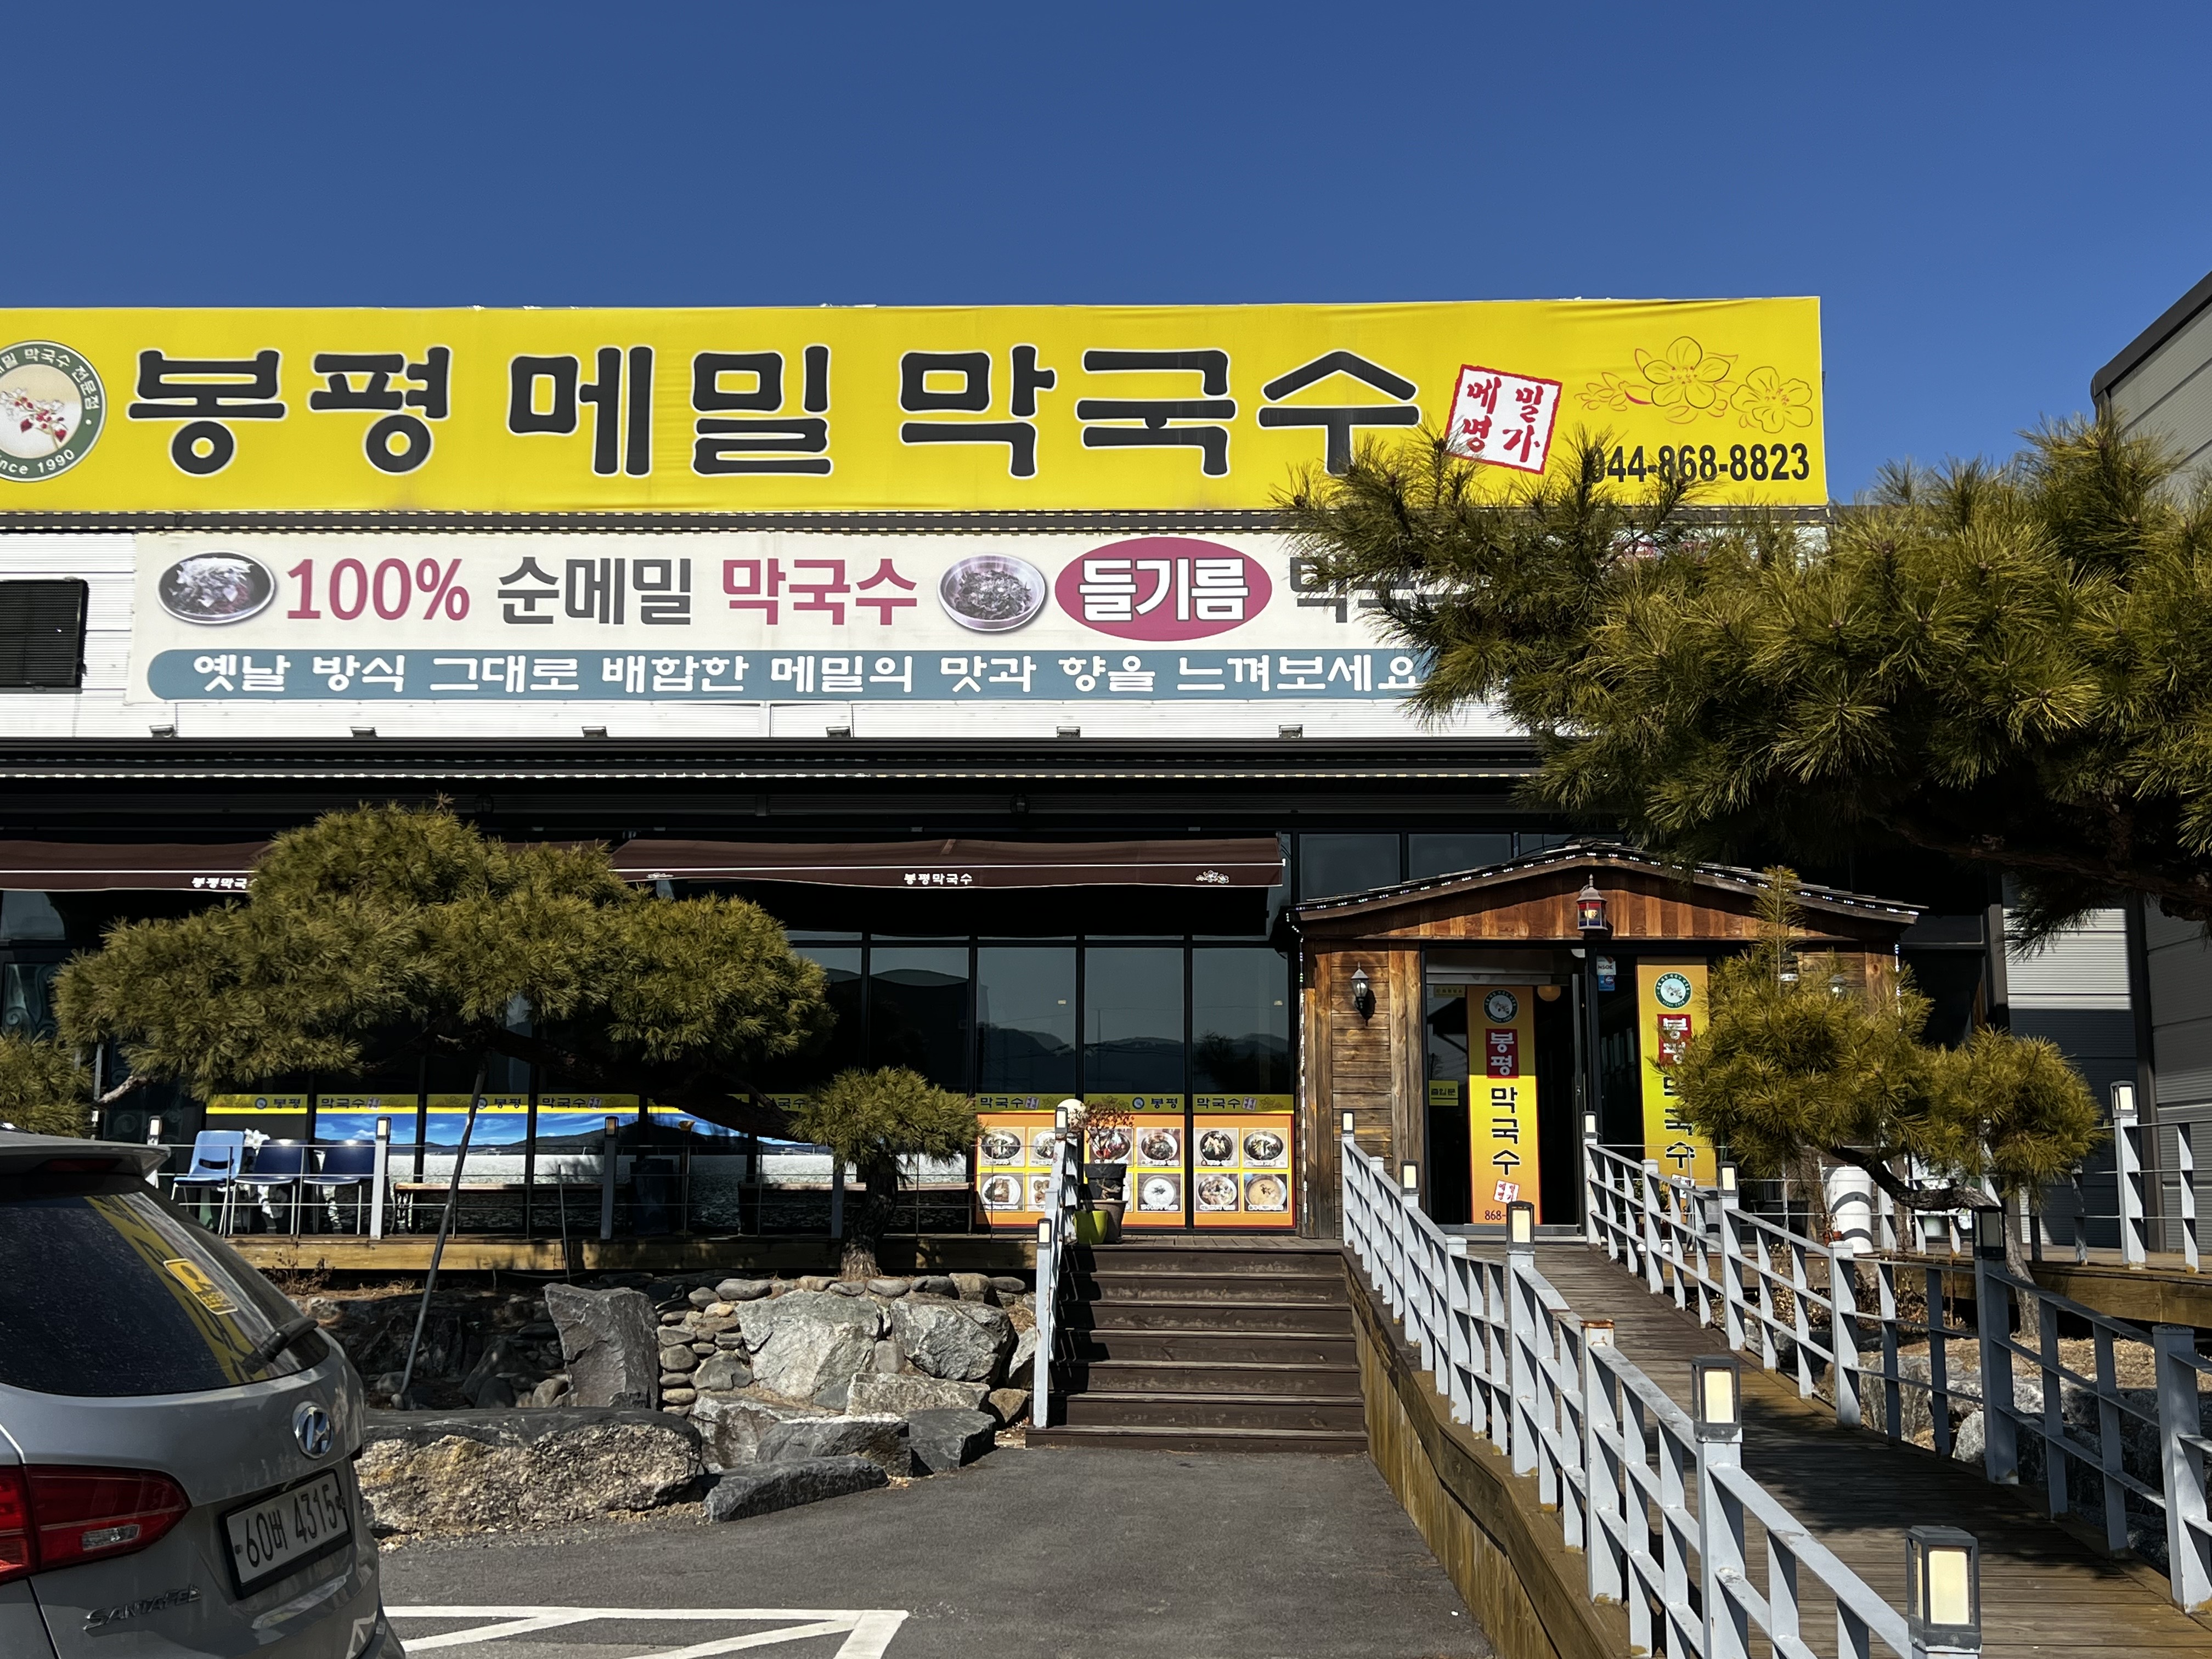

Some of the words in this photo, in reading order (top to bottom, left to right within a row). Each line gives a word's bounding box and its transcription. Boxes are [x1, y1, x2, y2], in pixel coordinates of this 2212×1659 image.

[0, 352, 19, 375] 밀
[24, 348, 71, 368] 막국수
[71, 365, 100, 410] 전문점
[128, 346, 450, 476] 봉평
[507, 346, 833, 476] 메밀
[899, 344, 1419, 477] 막국수
[1466, 376, 1544, 423] 메밀
[0, 454, 29, 474] nce
[37, 448, 75, 473] 1990
[1588, 443, 1810, 483] 044-868-8823
[287, 557, 470, 620] 100%
[497, 556, 692, 625] 순메밀
[722, 558, 918, 625] 막국수
[1079, 557, 1249, 622] 들기름
[194, 654, 291, 692] 옛날
[312, 654, 405, 692] 방식
[430, 654, 579, 692] 그대로
[602, 654, 749, 692] 배합한
[770, 654, 913, 692] 메밀의
[940, 654, 1037, 692] 맛과
[1058, 654, 1155, 692] 향을
[1177, 654, 1419, 692] 느껴보세요
[904, 873, 973, 885] 봉평막국수
[1489, 1031, 1515, 1076] 봉평
[321, 1098, 365, 1109] 막국수
[541, 1097, 586, 1109] 막국수
[980, 1097, 1024, 1109] 막국수
[1150, 1097, 1178, 1109] 봉평
[1197, 1097, 1241, 1109] 막국수
[1491, 1086, 1520, 1176] 막국수
[1485, 1210, 1506, 1221] 868-
[294, 1483, 338, 1543] 4315
